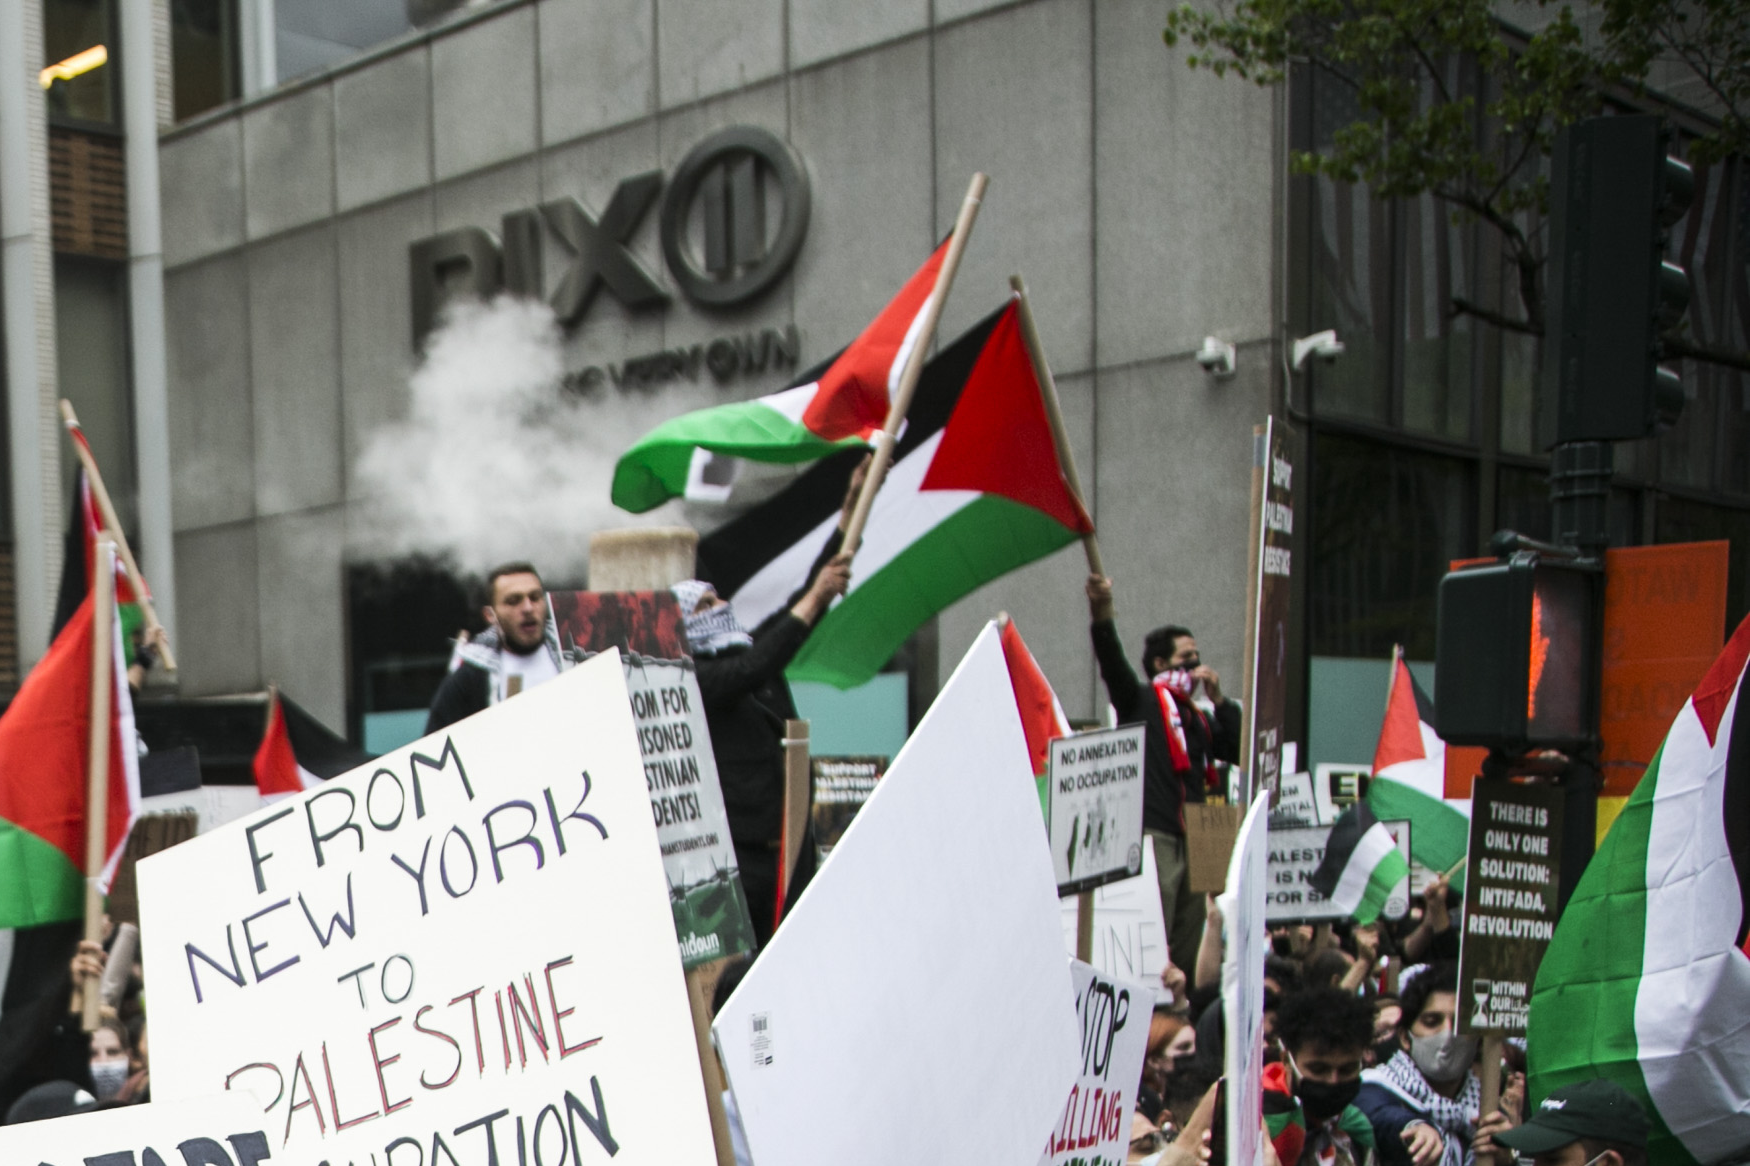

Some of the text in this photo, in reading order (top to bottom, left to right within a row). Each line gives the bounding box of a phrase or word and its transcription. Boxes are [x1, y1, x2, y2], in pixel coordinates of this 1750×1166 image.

[660, 685, 691, 715] FOR
[1061, 736, 1139, 767] NO ANNEXATION
[1060, 764, 1139, 794] NO OCCUPATION
[245, 735, 476, 896] FROM
[1490, 801, 1548, 827] THERE IS
[1268, 847, 1325, 864] ALEST
[1485, 829, 1549, 856] ONLY ONE
[1276, 870, 1293, 884] IS
[1480, 858, 1551, 884] SOLUTION:
[184, 770, 610, 1004] NEW YORK
[1479, 886, 1546, 913] INTIFADA,
[1468, 913, 1553, 940] REVOLUTION
[337, 953, 415, 1012] TO
[1491, 980, 1527, 998] WITHIN
[1490, 996, 1511, 1011] OUR
[1082, 976, 1130, 1082] STOP
[1489, 1011, 1528, 1029] LIFETIM
[224, 955, 605, 1150] PALESTINE
